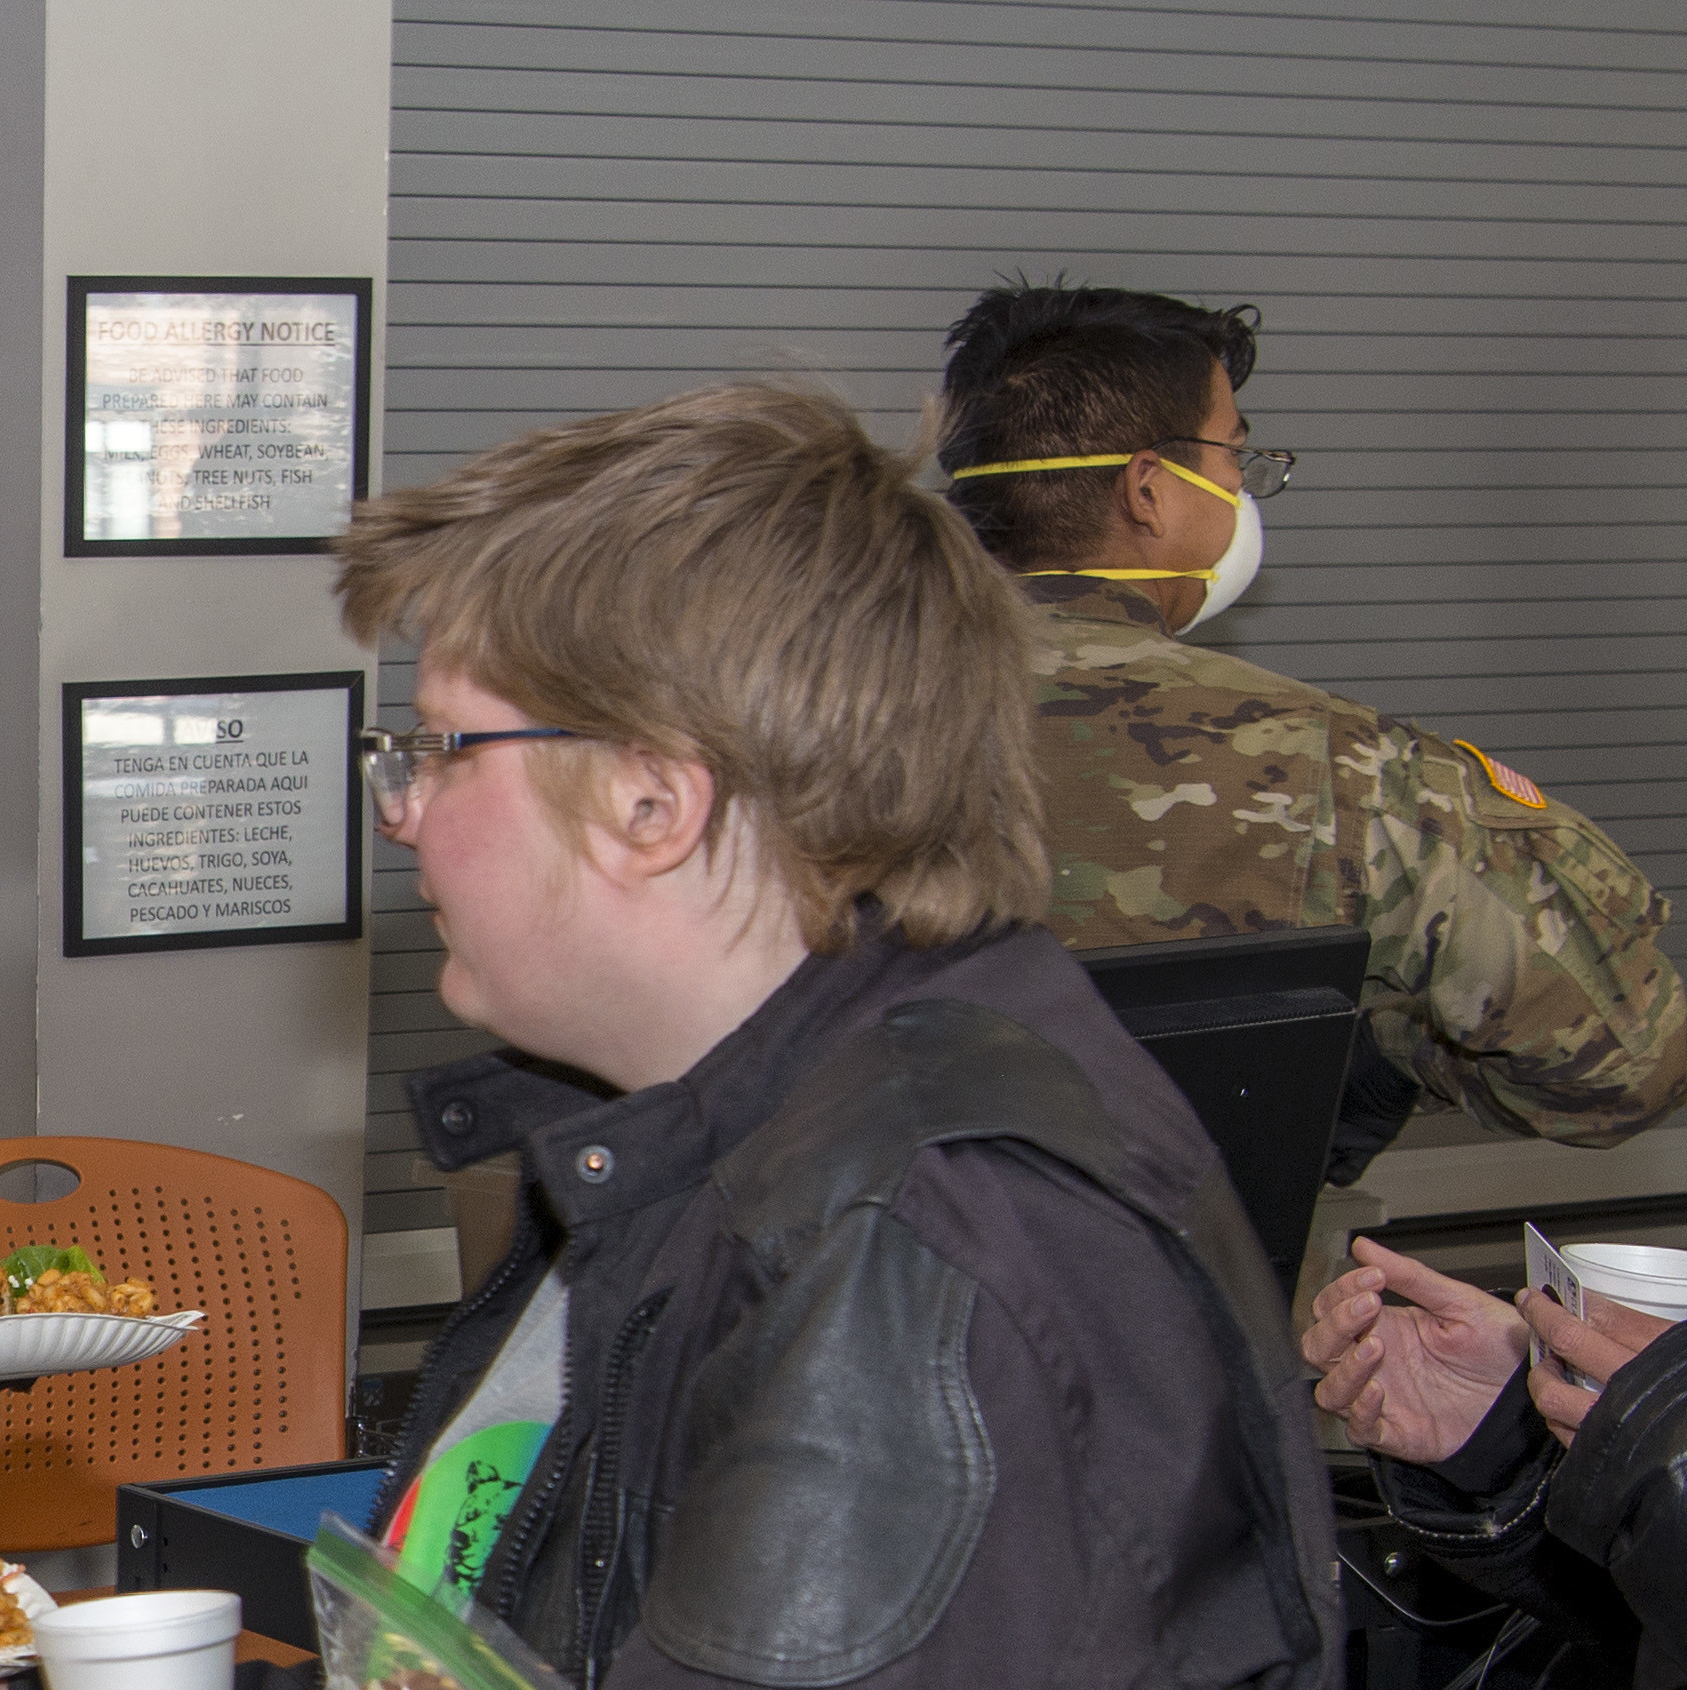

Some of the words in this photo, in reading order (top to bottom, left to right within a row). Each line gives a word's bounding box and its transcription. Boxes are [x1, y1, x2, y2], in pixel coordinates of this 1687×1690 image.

[97, 322, 159, 340] FOOD
[164, 322, 255, 342] ALLERGY
[261, 322, 335, 342] NOTICE
[129, 368, 147, 382] BE
[151, 368, 215, 382] ADVISED
[221, 368, 257, 382] THAT
[261, 368, 303, 382] FOOD
[103, 394, 177, 409] PREPARED
[185, 394, 221, 408] HERE
[227, 394, 259, 408] MAY
[263, 394, 328, 408] CONTAIN
[190, 420, 291, 434] INGREDIENTS:
[197, 446, 253, 462] WHEAT,
[257, 446, 329, 462] SOYBEAN,
[193, 470, 229, 486] TREE
[233, 470, 277, 488] NUTS,
[281, 470, 313, 486] FISH
[159, 496, 191, 510] AND
[194, 496, 271, 510] SHELLFISH
[113, 758, 165, 774] TENGA
[169, 756, 189, 772] EN
[193, 753, 252, 770] CUENTA
[255, 752, 287, 768] QUE
[291, 750, 309, 766] LA
[114, 782, 176, 800] COMIDA
[181, 778, 266, 796] PREPARADA
[270, 776, 309, 792] AQUI
[121, 807, 169, 824] PUEDE
[173, 804, 253, 821] CONTENER
[257, 800, 301, 816] ESTOS
[128, 828, 239, 848] INGREDIENTES:
[243, 825, 293, 844] LECHE,
[128, 856, 195, 874] HUEVOS,
[198, 852, 247, 870] TRIGO,
[251, 850, 293, 868] SOYA,
[127, 878, 228, 898] CACAHUATES,
[231, 874, 293, 893] NUECES,
[130, 904, 199, 922] PESCADO
[201, 904, 211, 918] Y
[215, 898, 291, 918] MARISCOS
